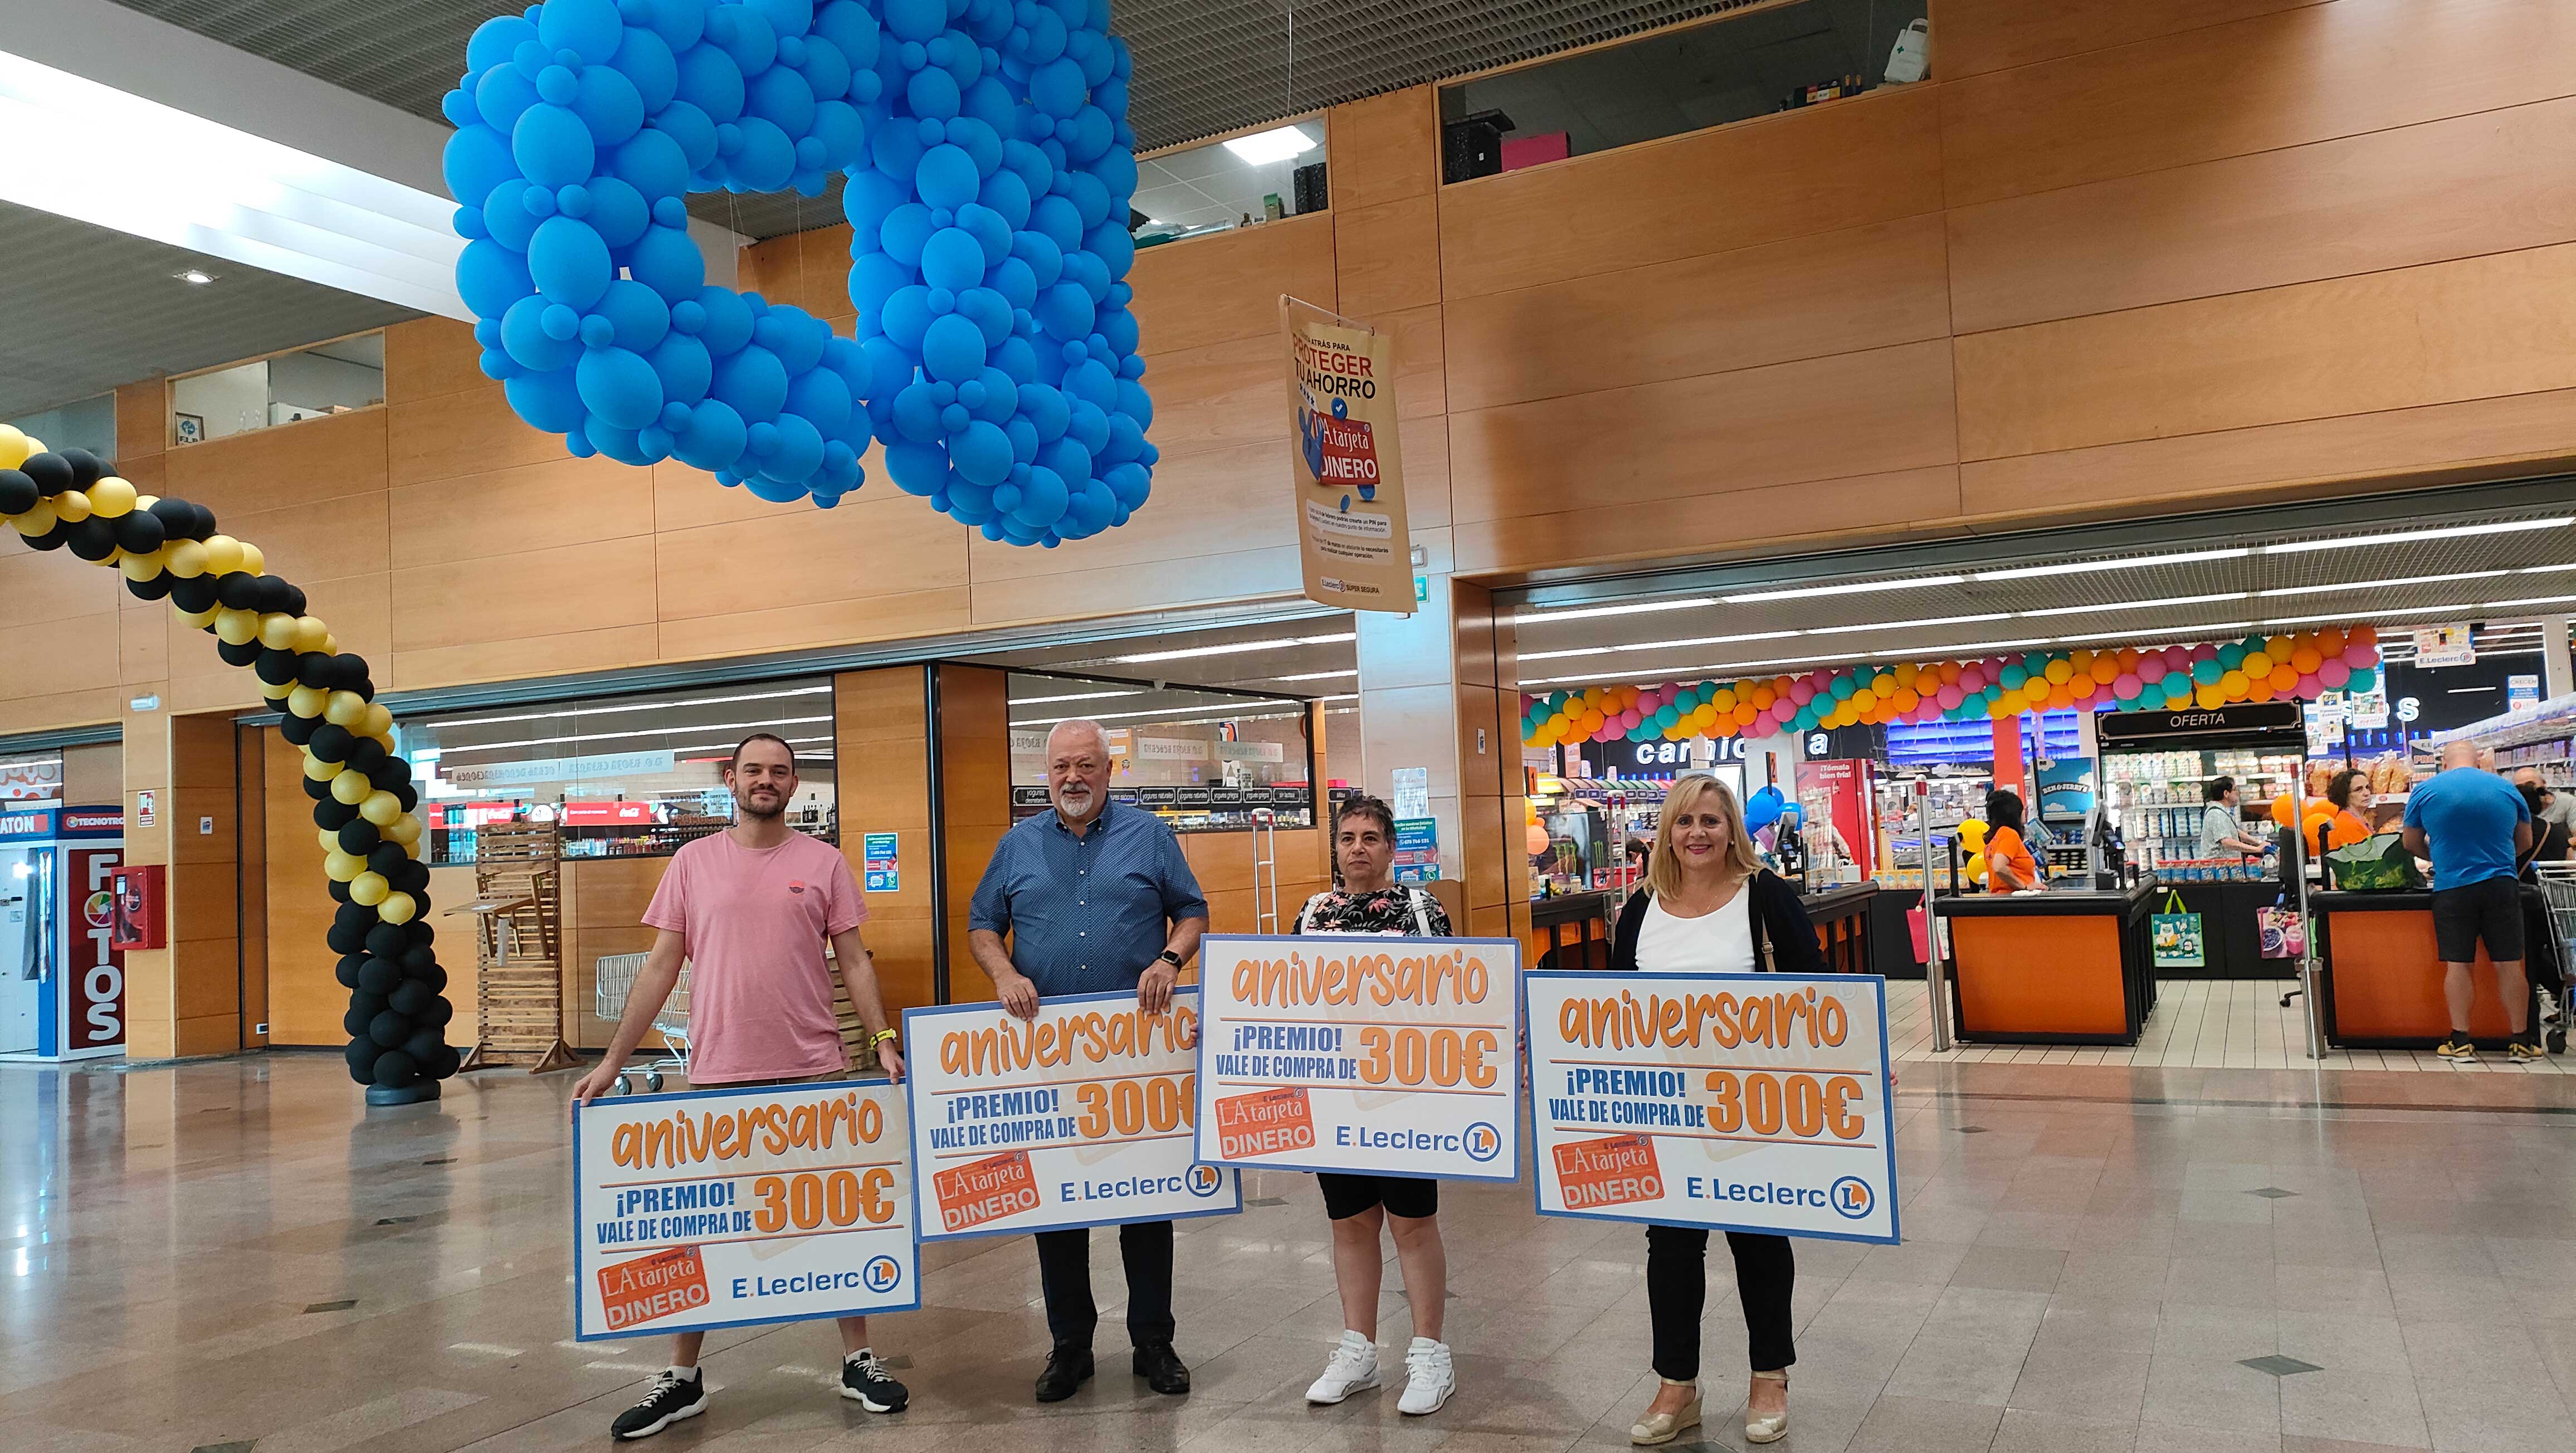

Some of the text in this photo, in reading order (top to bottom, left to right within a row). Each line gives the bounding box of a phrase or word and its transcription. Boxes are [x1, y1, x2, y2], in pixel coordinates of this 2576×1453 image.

[1292, 333, 1373, 378] PROTEGER
[1311, 339, 1350, 351] ATRÁS PARA
[1295, 357, 1375, 399] TU AHORRO
[1333, 428, 1369, 452] tarjeta
[2170, 713, 2226, 728] OFERTA
[1531, 772, 1535, 792] 1
[1770, 758, 1775, 779] 2
[1142, 792, 1157, 801] yogures
[1179, 792, 1193, 801] yogures
[1213, 792, 1239, 801] yogures griegos
[1246, 792, 1270, 801] yogures griegos
[1232, 949, 1489, 1010] aniversario
[1560, 987, 1848, 1051] aniversario
[940, 1006, 1196, 1077] aniversario
[1234, 1025, 1499, 1089] ¡PREMIO! 300€
[1216, 1055, 1357, 1080] VALE DE COMPRA DE
[948, 1089, 1059, 1125] ¡PREMIO!
[1218, 1100, 1303, 1127] LA tarjeta
[1549, 1098, 1705, 1128] VALE DE COMPRA DE
[1567, 1069, 1865, 1140] ¡PREMIO! 300€
[612, 1092, 884, 1171] aniversario
[930, 1116, 1076, 1149] VALE DE COMPRA DE
[1222, 1125, 1311, 1156] DINERO
[1336, 1125, 1460, 1152] E.Leclerc
[1556, 1147, 1648, 1176] LA tarjeta
[936, 1165, 1025, 1201] LA tarjeta
[1061, 1174, 1183, 1202] E.Leclerc
[1563, 1175, 1660, 1206] DINERO
[1687, 1177, 1827, 1208] E.Leclerc
[617, 1168, 896, 1234] ¡PREMIO! 300€
[944, 1187, 1036, 1228] DINERO
[597, 1210, 752, 1245] VALE DE COMPRA DE
[602, 1260, 696, 1298] LA tarjeta
[733, 1267, 860, 1299] E.Leclerc
[607, 1283, 706, 1327] DINERO
